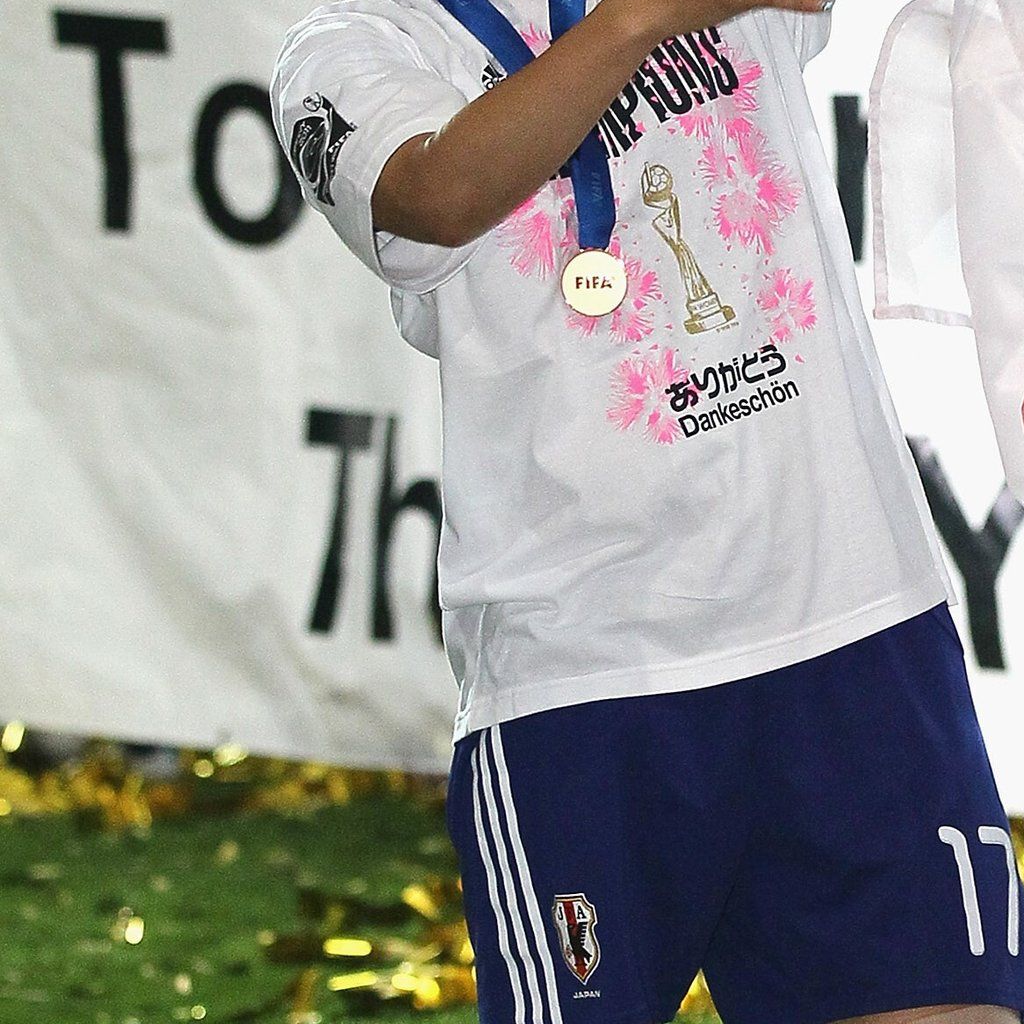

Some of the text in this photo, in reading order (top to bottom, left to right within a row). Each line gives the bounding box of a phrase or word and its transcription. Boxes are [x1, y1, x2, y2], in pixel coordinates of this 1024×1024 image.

[575, 276, 613, 289] FIFA
[664, 343, 788, 413] ありがとう
[677, 380, 801, 439] Dankeschön
[937, 825, 1020, 957] 17
